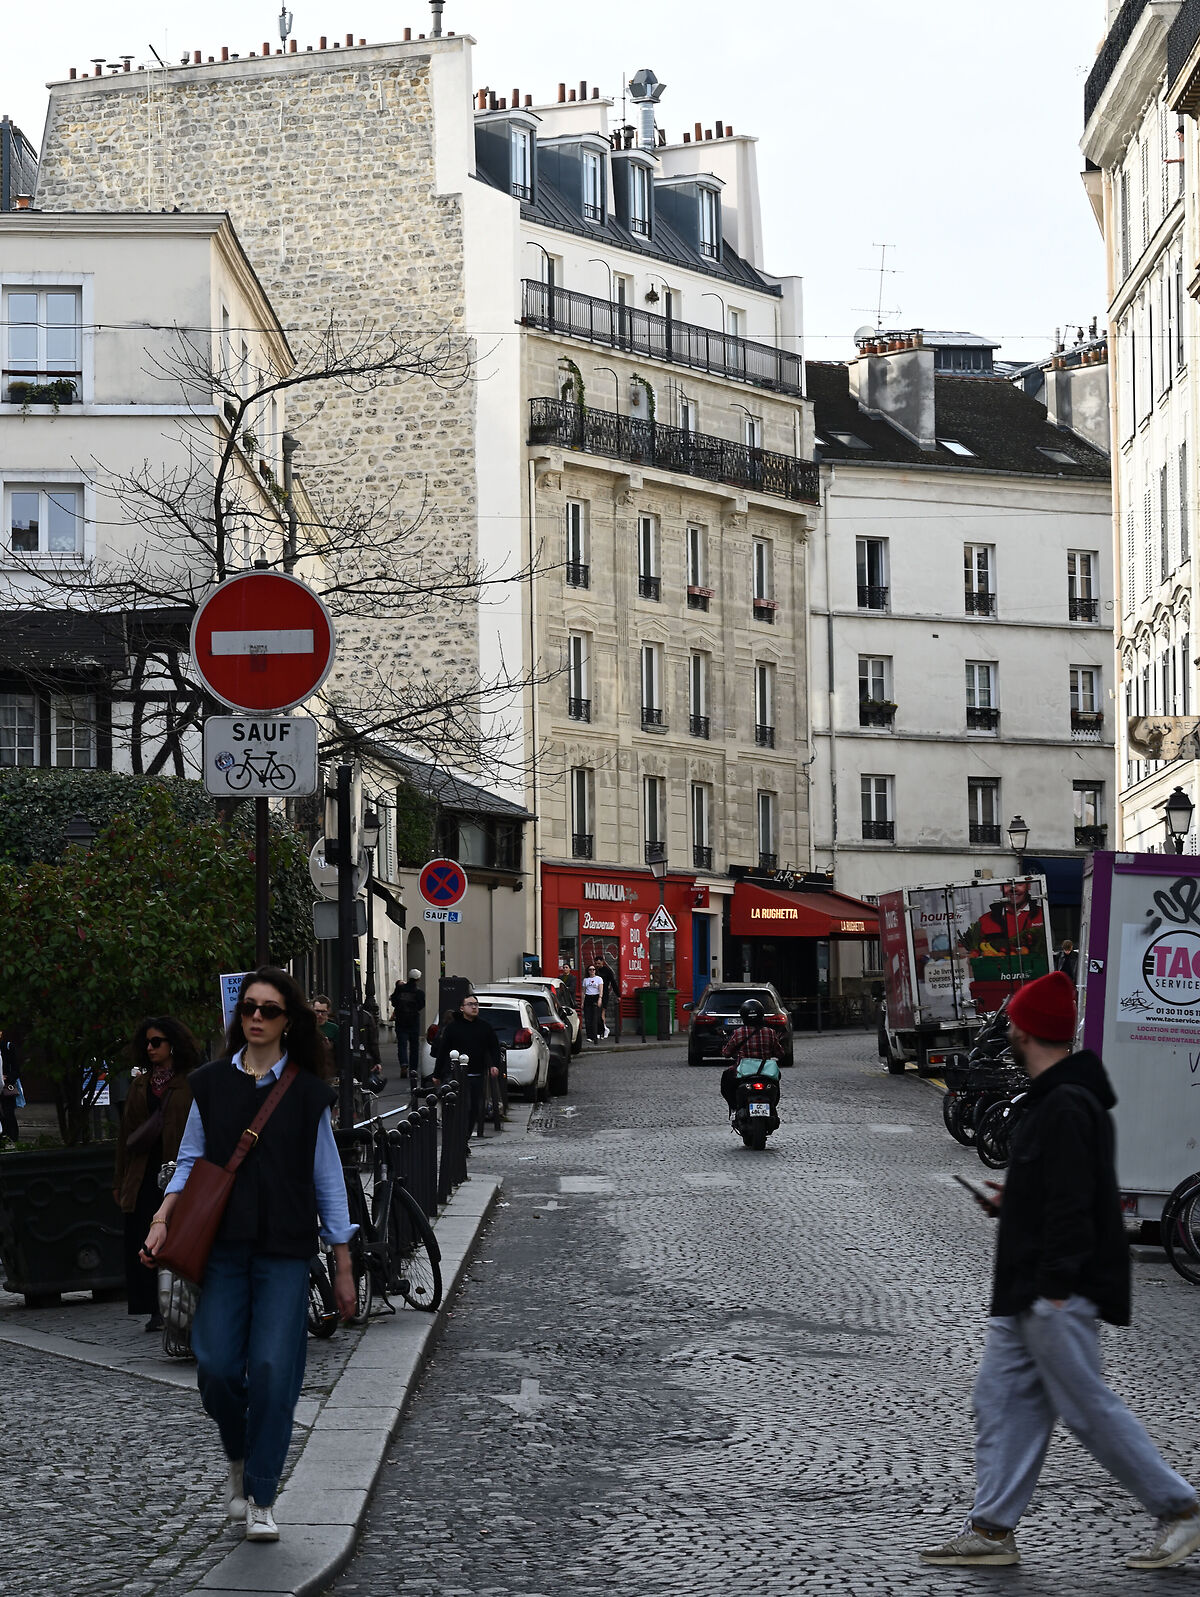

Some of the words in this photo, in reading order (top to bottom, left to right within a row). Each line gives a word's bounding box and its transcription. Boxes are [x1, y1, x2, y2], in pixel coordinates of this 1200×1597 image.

[232, 723, 291, 742] SAUF
[583, 882, 626, 902] NATURALIA
[425, 911, 448, 920] SAUF
[751, 908, 760, 919] LA
[761, 908, 798, 920] RUGHETTA
[630, 929, 640, 943] BIO
[629, 960, 642, 971] LOCAL
[1137, 1025, 1169, 1033] LOCATION
